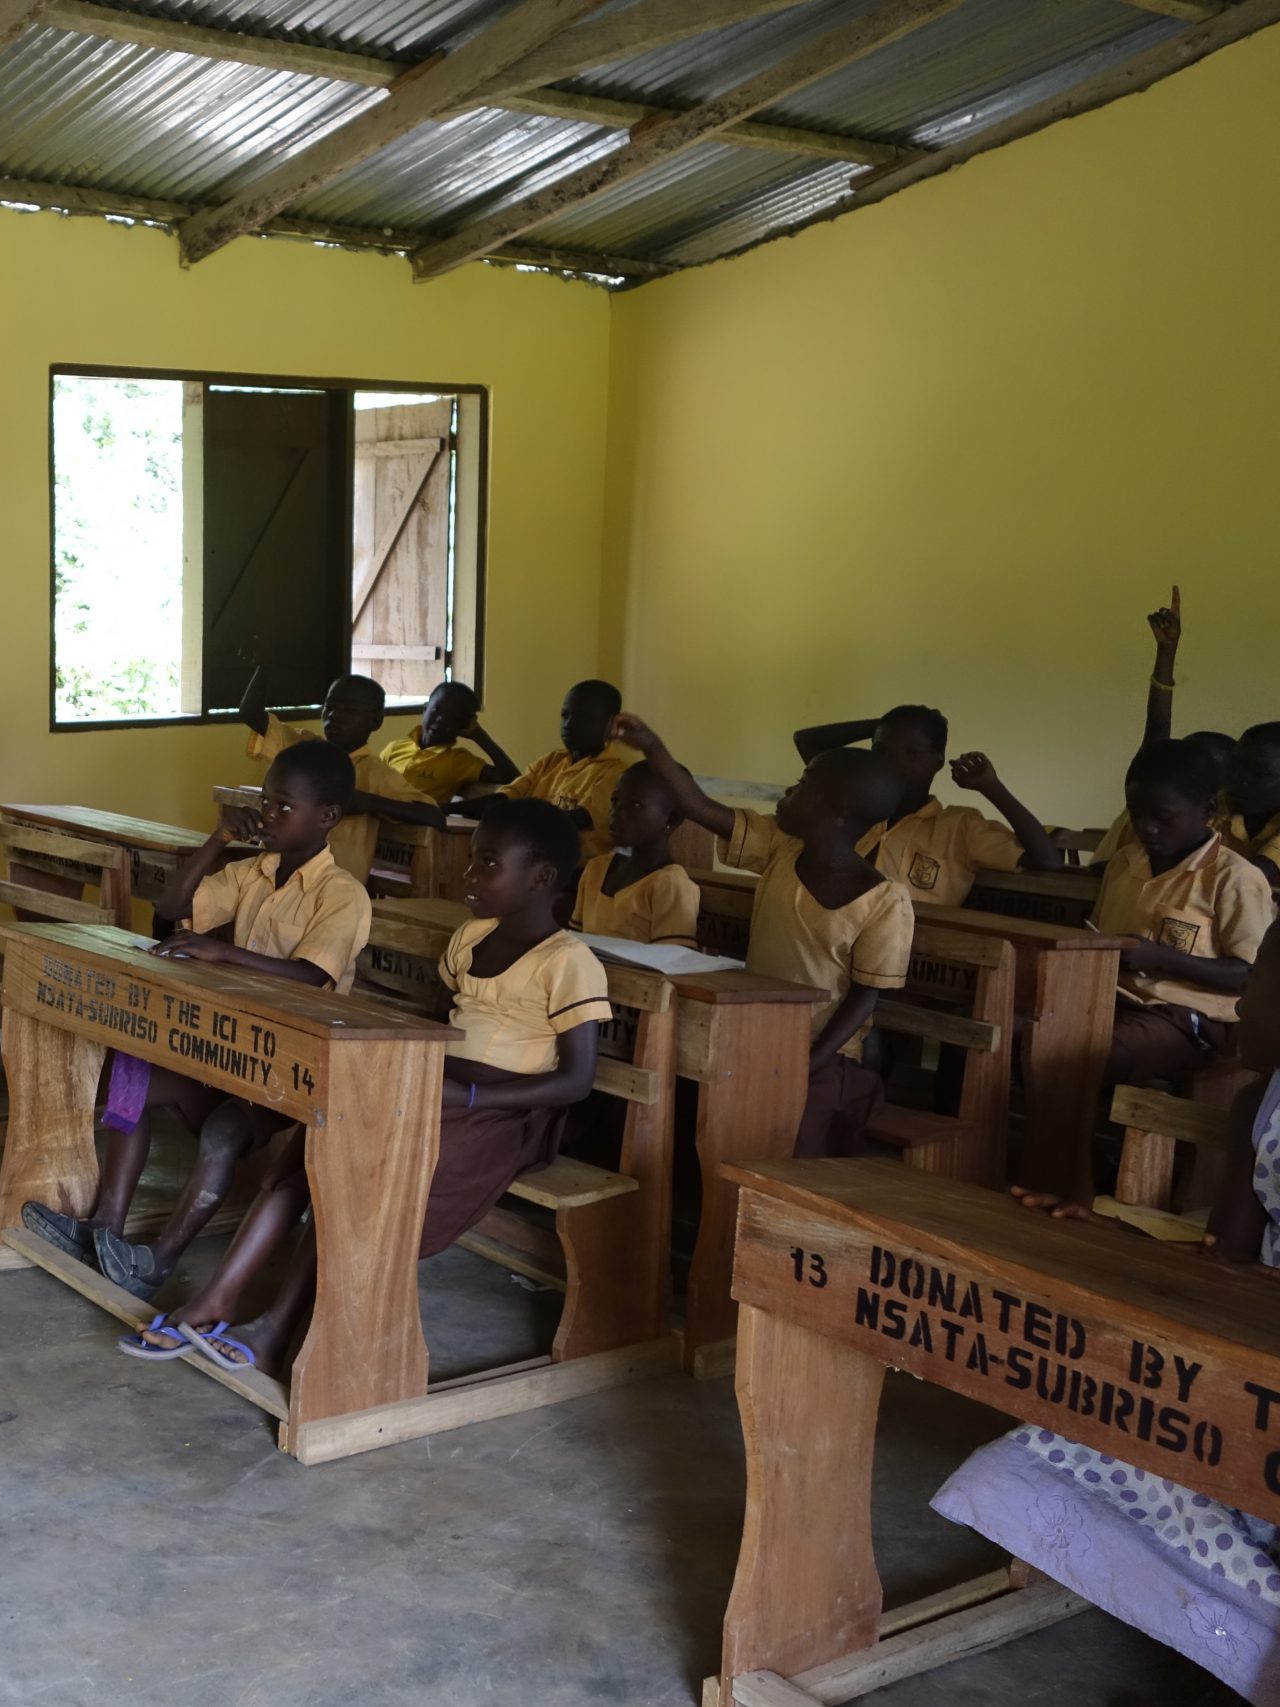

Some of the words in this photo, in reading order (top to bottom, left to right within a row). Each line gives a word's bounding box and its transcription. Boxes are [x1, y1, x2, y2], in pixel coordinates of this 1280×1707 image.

[36, 981, 158, 1045] NSATA-SUBRISO
[168, 1028, 272, 1087] COMMUNITY
[291, 1062, 315, 1096] 14
[42, 954, 116, 1000] DONATED
[128, 982, 151, 1011] BY
[163, 994, 201, 1030] THE
[251, 1024, 276, 1058] TO
[790, 1246, 828, 1288] 13
[870, 1245, 1086, 1361] DONATED
[1129, 1339, 1203, 1403] BY
[855, 1287, 1224, 1467] NSATA-SUBRISO
